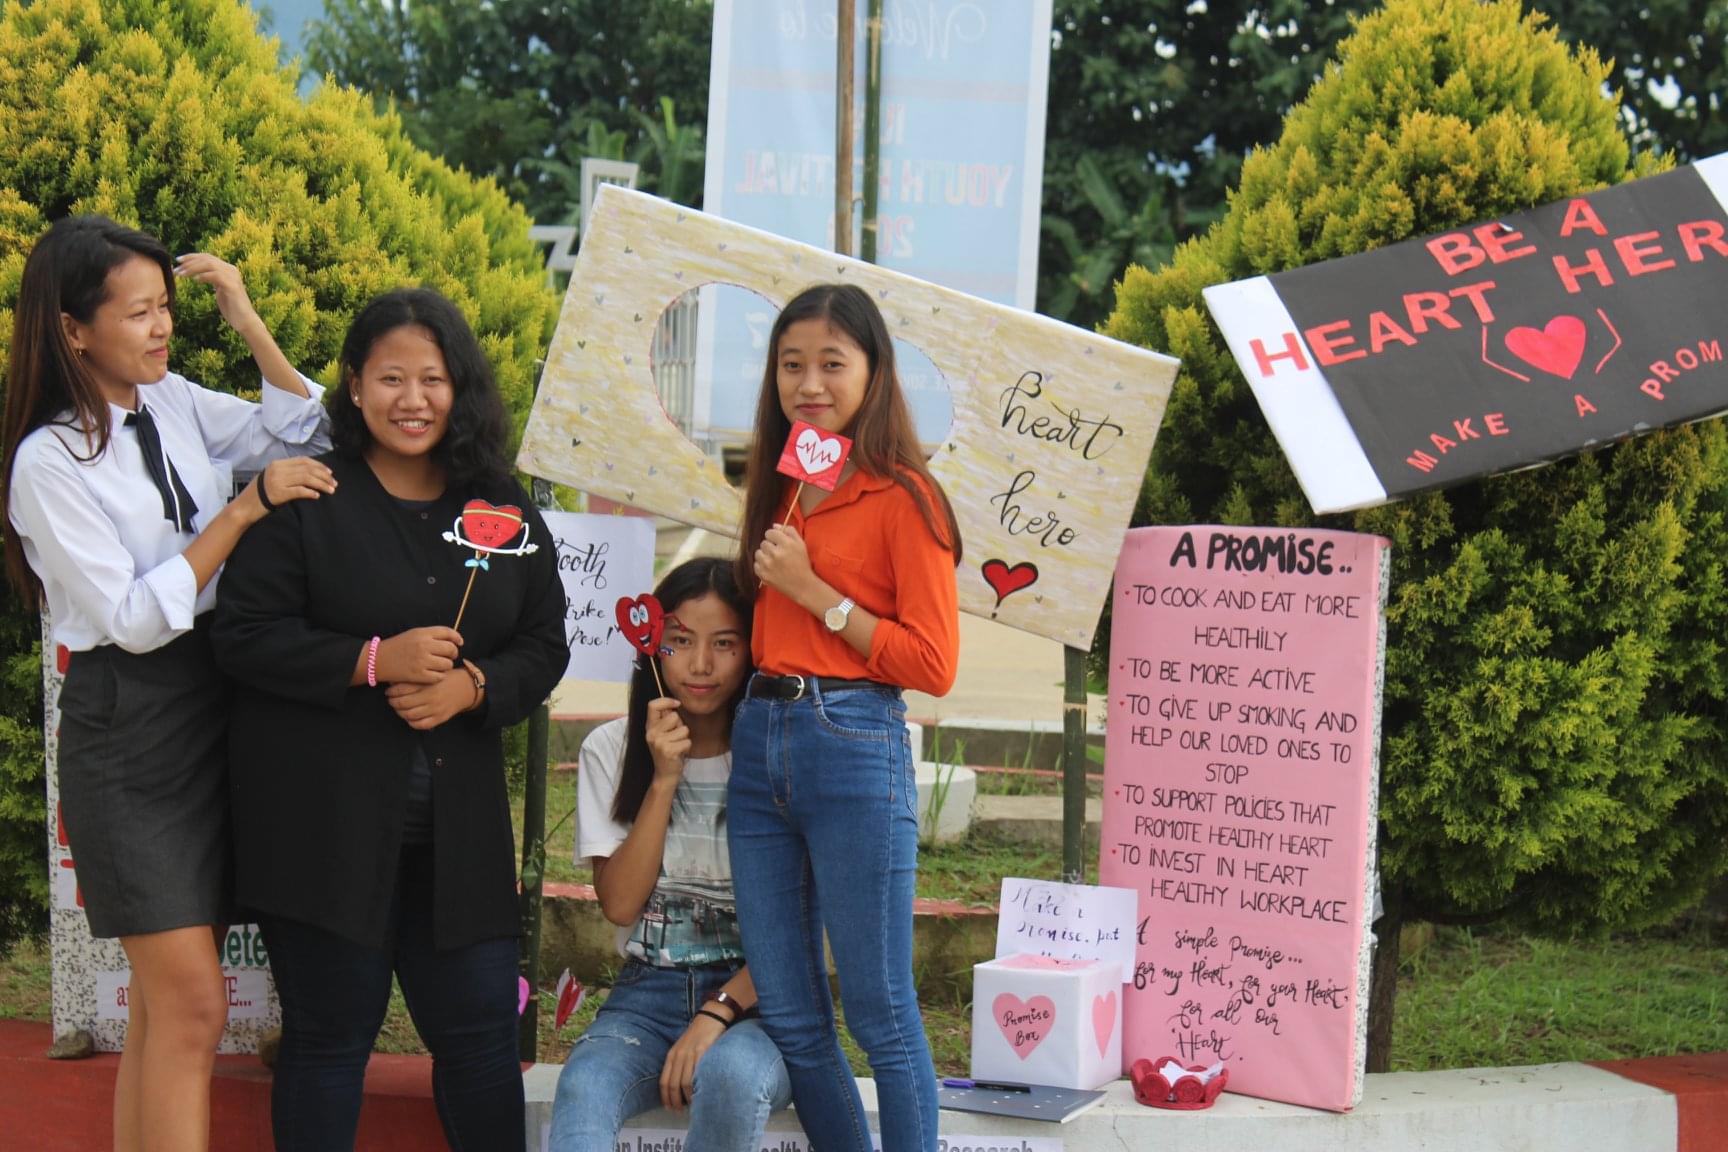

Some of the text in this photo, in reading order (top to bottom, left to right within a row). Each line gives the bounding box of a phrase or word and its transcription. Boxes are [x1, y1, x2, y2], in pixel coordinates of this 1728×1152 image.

[1425, 199, 1609, 276] BE A
[1248, 280, 1498, 377] HEART
[999, 370, 1124, 460] heart
[1405, 413, 1510, 474] MAKE
[1573, 393, 1598, 417] A
[990, 470, 1080, 548] hero
[1169, 531, 1197, 569] A
[1133, 584, 1360, 619] TO COOK AND EAT MORE
[1127, 658, 1151, 679] TO
[1159, 660, 1181, 682] BE
[1190, 663, 1239, 687] MORE
[1126, 694, 1150, 716] TO
[1208, 702, 1231, 721] UP
[1239, 703, 1306, 733] SMOKING
[1315, 711, 1357, 733] AND
[1131, 725, 1352, 764] HELP OUR LOVED ONES TO
[1205, 762, 1249, 784] STOP
[1123, 784, 1145, 805] TO
[1151, 787, 1218, 814] SUPPORT
[1289, 802, 1337, 827] THAT
[1134, 815, 1334, 859] PROMOTE HEALTHY HEART
[1118, 842, 1141, 865] TO
[1217, 856, 1235, 878] IN
[1243, 862, 1310, 887] HEART
[1151, 877, 1349, 924] HEALTHY WORKPLACE
[1161, 967, 1183, 996] my
[1267, 982, 1298, 1008] your
[1210, 998, 1242, 1026] all
